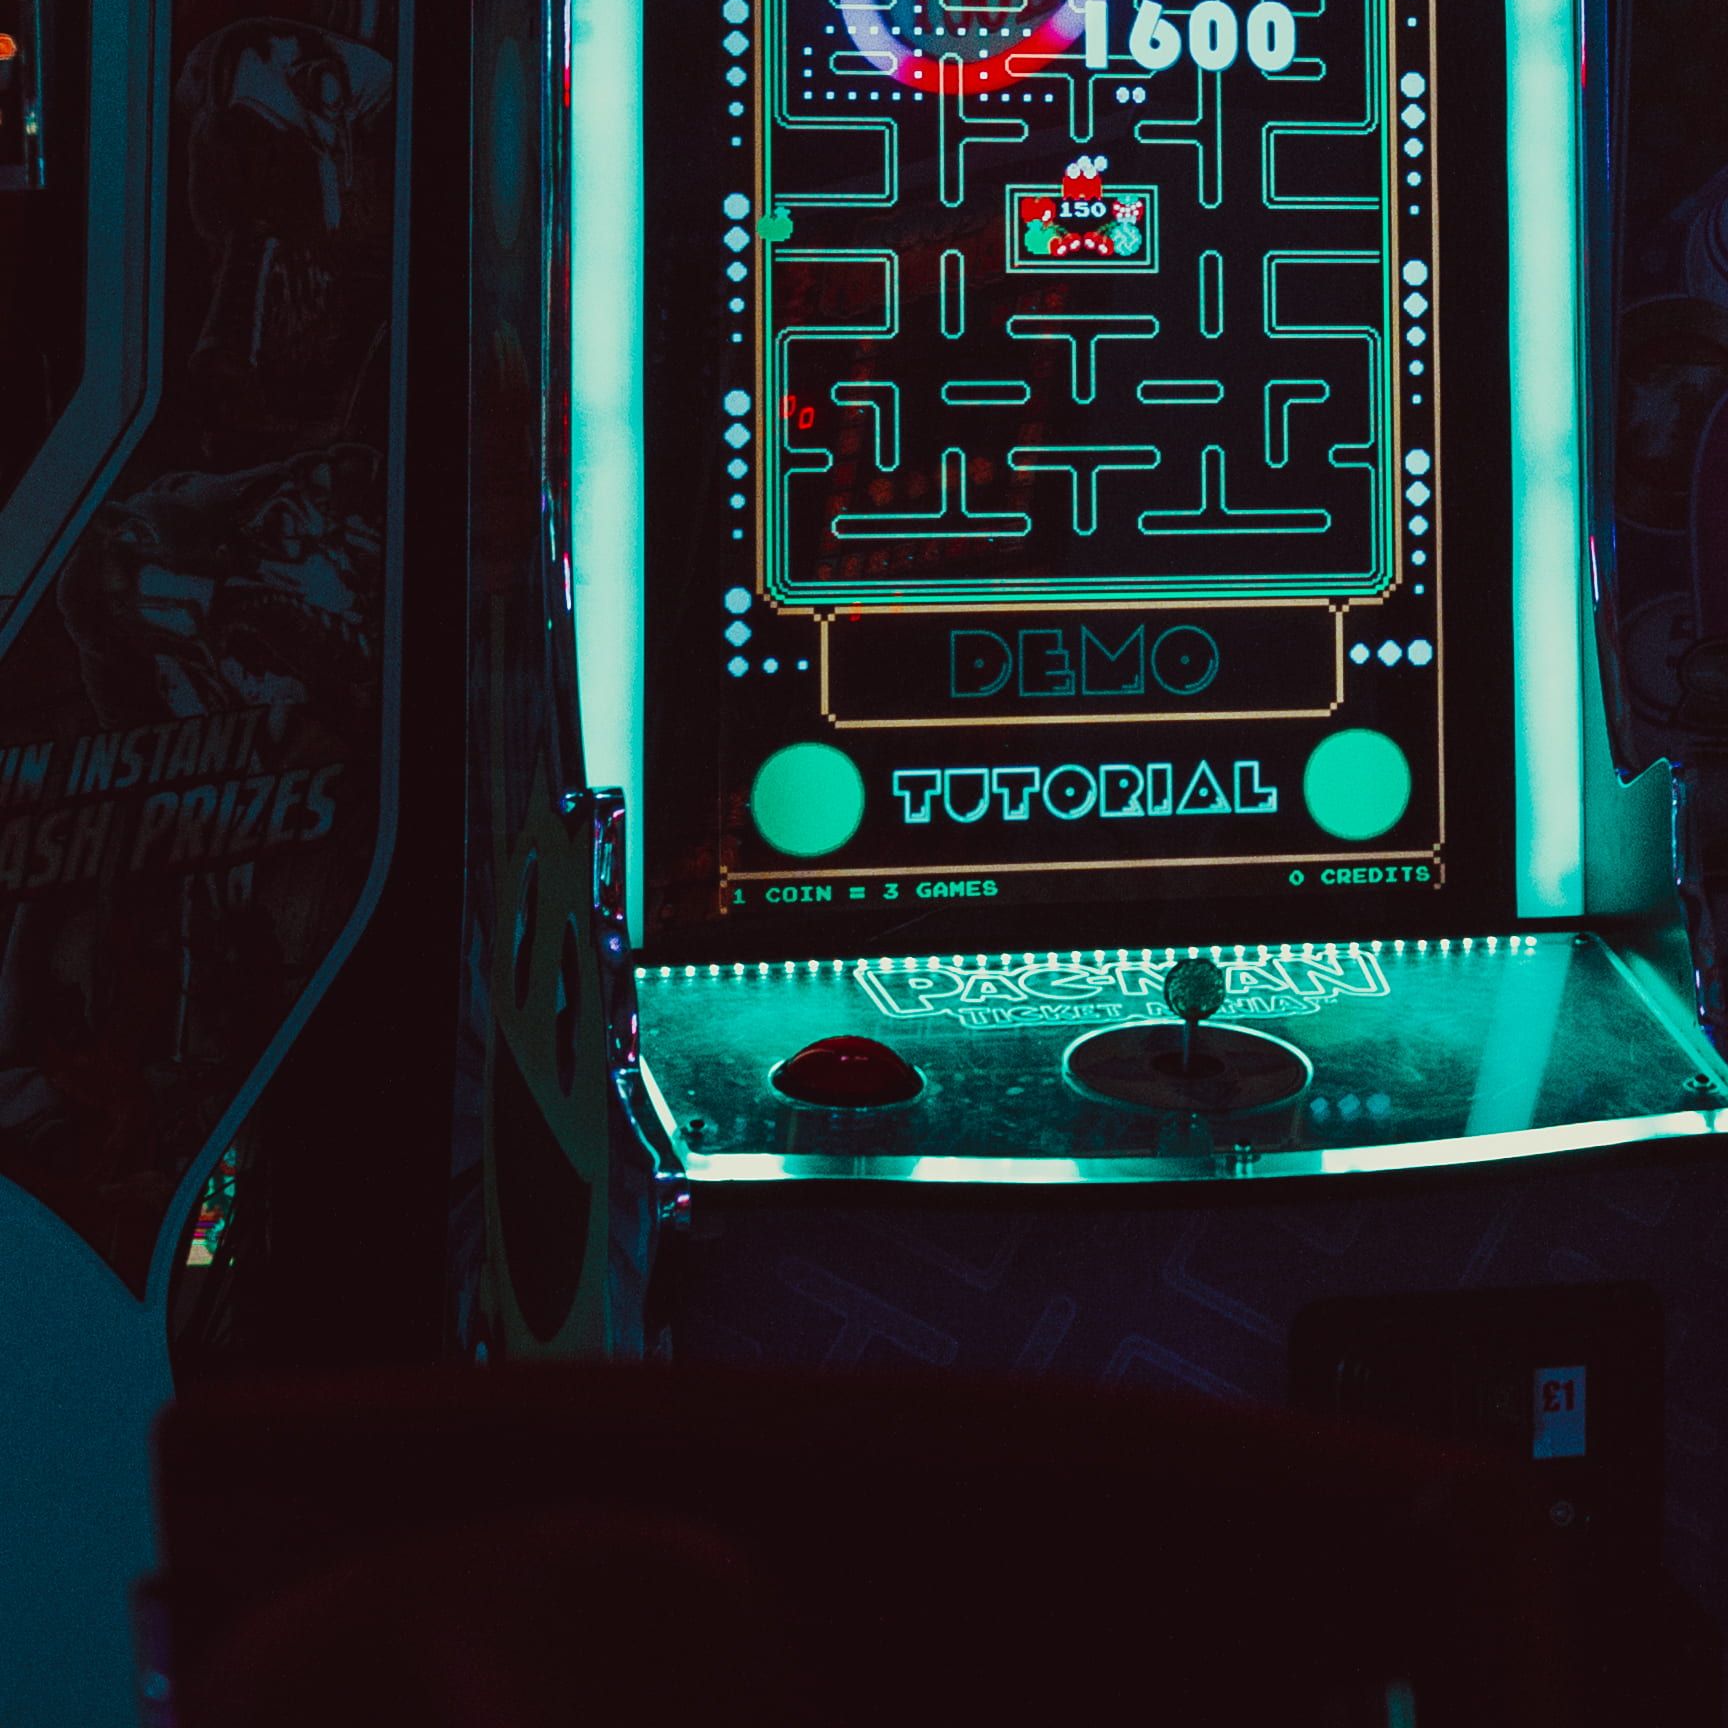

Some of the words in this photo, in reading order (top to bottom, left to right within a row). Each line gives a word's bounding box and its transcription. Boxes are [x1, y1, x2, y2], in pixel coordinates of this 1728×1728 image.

[1085, 0, 1297, 71] 1600
[1059, 201, 1107, 218] 150
[950, 624, 1220, 698] DEMO
[0, 740, 56, 808] IN
[64, 705, 267, 797] INSTANT
[892, 760, 1278, 823] TUTORIAL
[130, 762, 346, 872] PRIZES
[733, 889, 746, 905] 1
[765, 885, 832, 904] COIN
[884, 882, 899, 900] 3
[916, 879, 999, 900] GAMES
[1288, 869, 1305, 887] 0
[1320, 866, 1431, 886] CREDITS
[959, 1002, 1122, 1028] TICKET
[1543, 1380, 1576, 1413] £1
